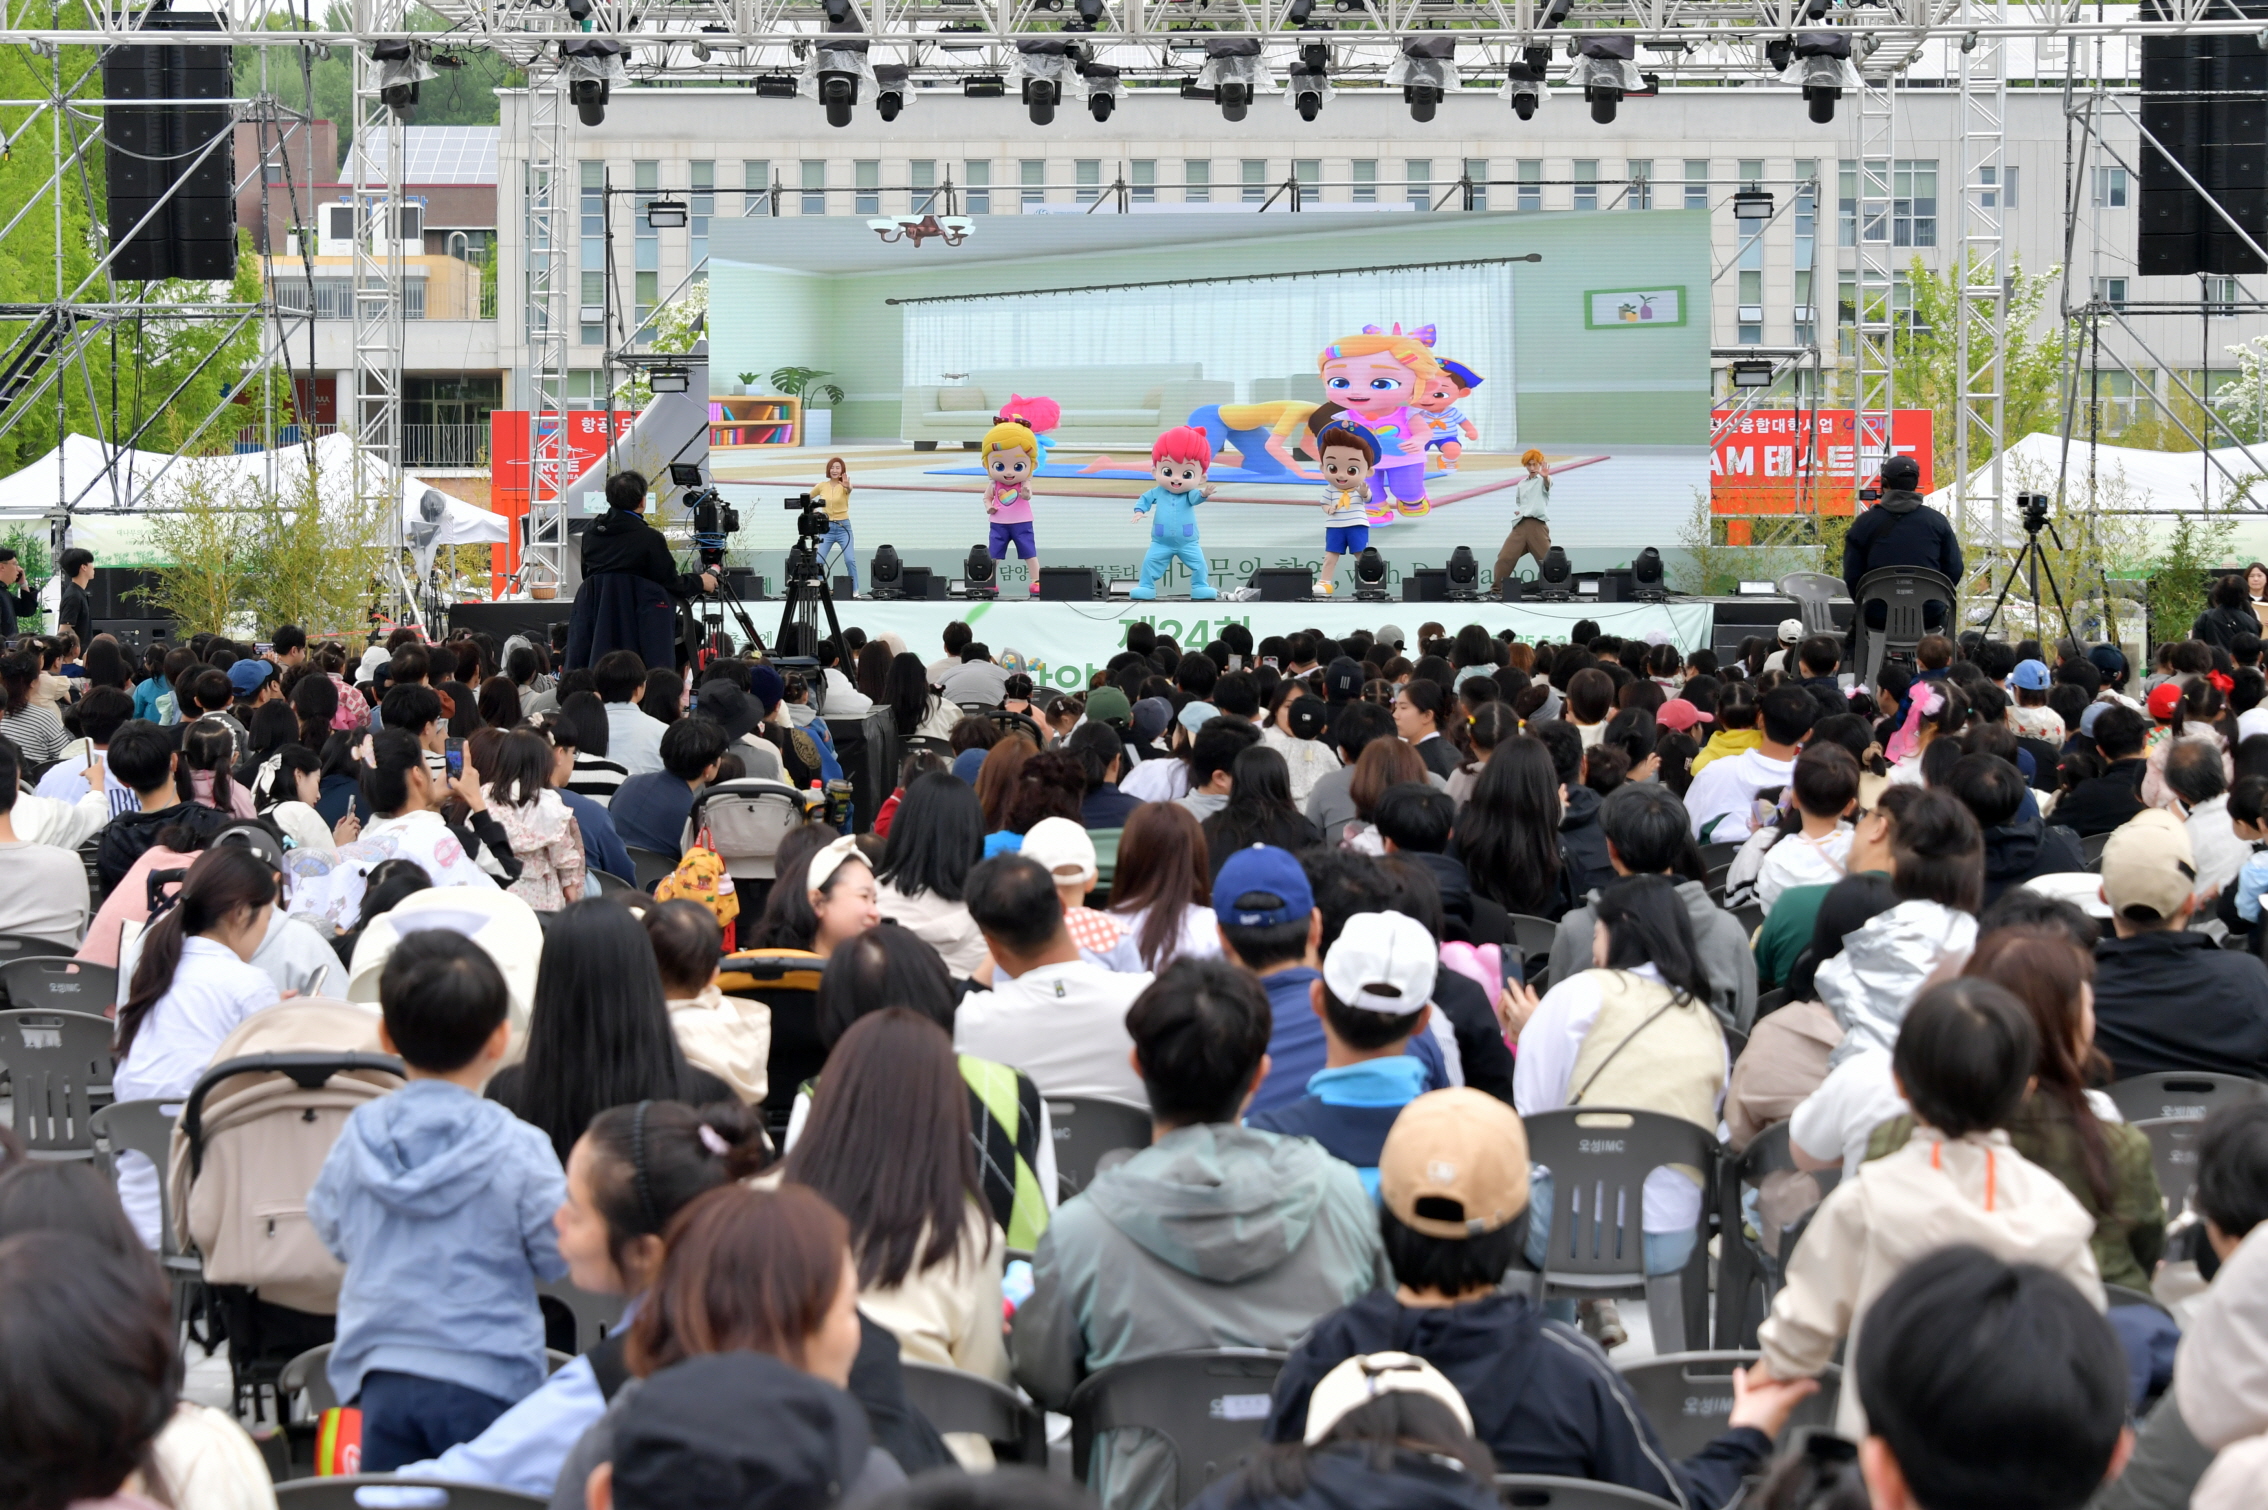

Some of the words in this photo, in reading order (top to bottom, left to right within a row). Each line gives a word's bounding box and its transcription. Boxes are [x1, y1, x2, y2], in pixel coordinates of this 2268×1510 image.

[999, 565, 1029, 581] 담양
[1579, 1139, 1626, 1154] 오성IMC
[1682, 1396, 1735, 1416] 오성IM
